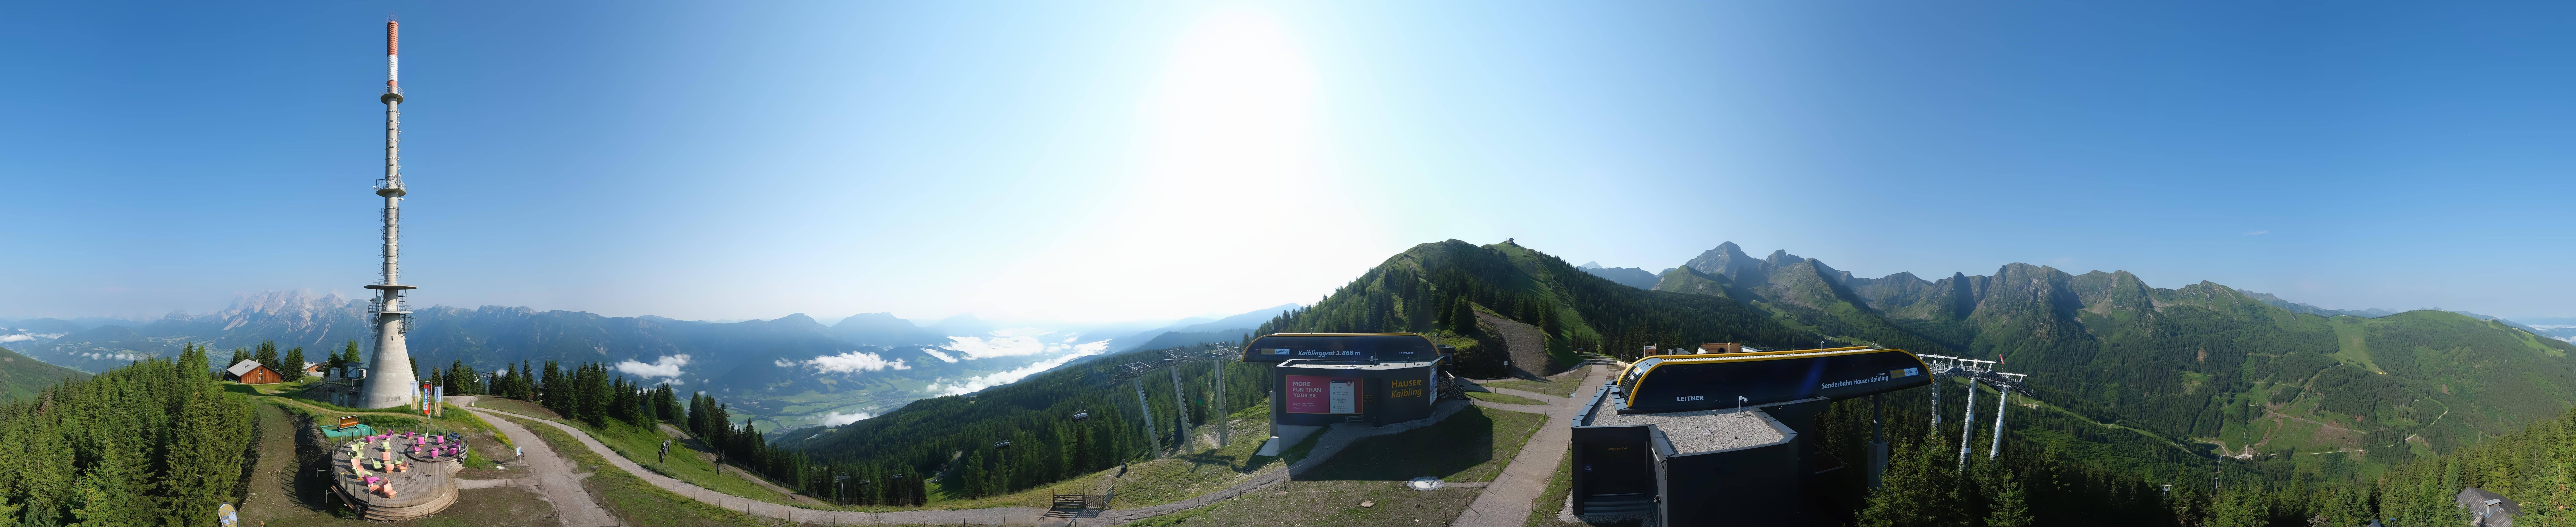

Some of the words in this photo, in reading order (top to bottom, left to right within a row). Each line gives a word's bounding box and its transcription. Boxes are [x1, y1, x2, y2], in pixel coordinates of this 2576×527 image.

[1392, 379, 1421, 388] HAUSER
[1822, 380, 1852, 389] Senderbahn
[1391, 388, 1422, 398] Kaibling
